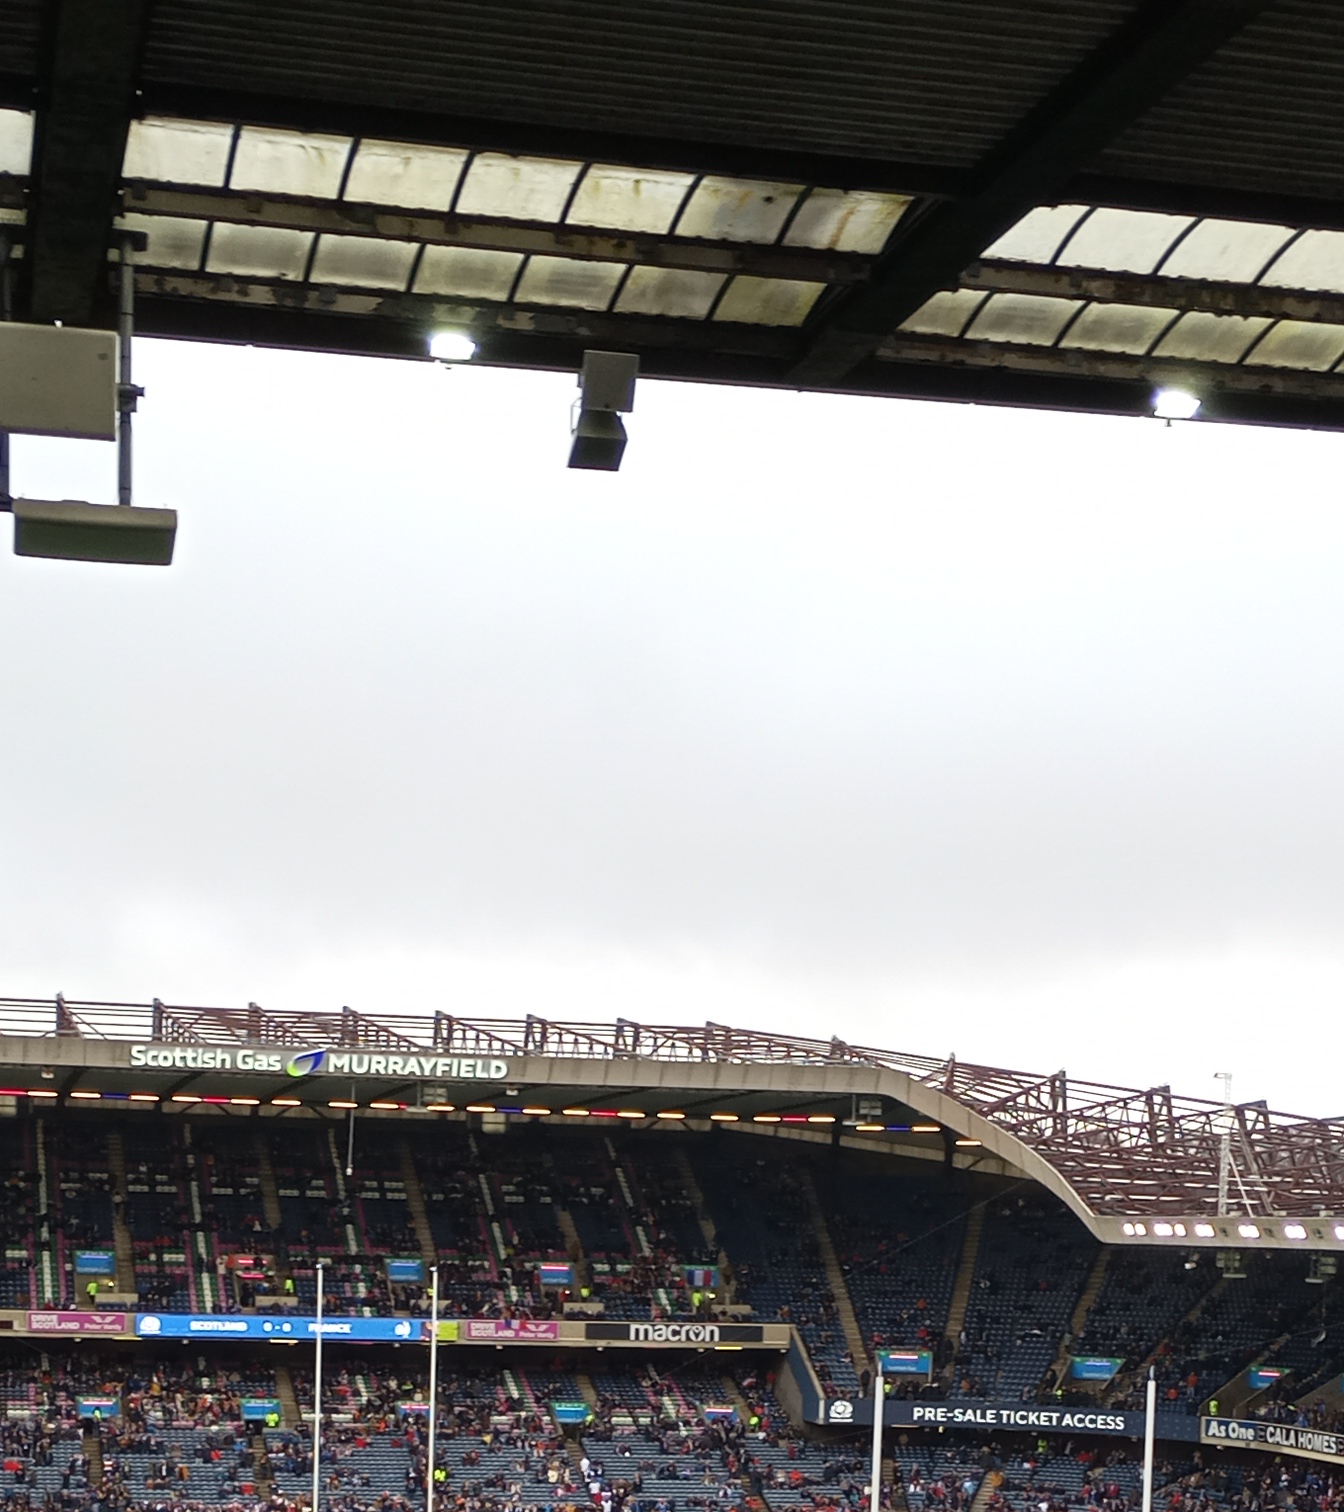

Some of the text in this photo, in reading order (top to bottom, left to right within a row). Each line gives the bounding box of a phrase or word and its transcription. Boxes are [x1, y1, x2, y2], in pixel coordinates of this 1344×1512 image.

[131, 1045, 508, 1080] Scottish Gas MURRAYFIELD
[31, 1322, 80, 1330] SCOTLAND
[190, 1321, 248, 1331] SCOTLAND
[308, 1323, 351, 1333] FANCE
[629, 1324, 719, 1342] macron
[913, 1407, 1125, 1430] PRE-SALE TICKET ACCESS
[1208, 1421, 1255, 1440] As One
[1266, 1427, 1296, 1447] CALA
[1298, 1432, 1337, 1453] HOMES
